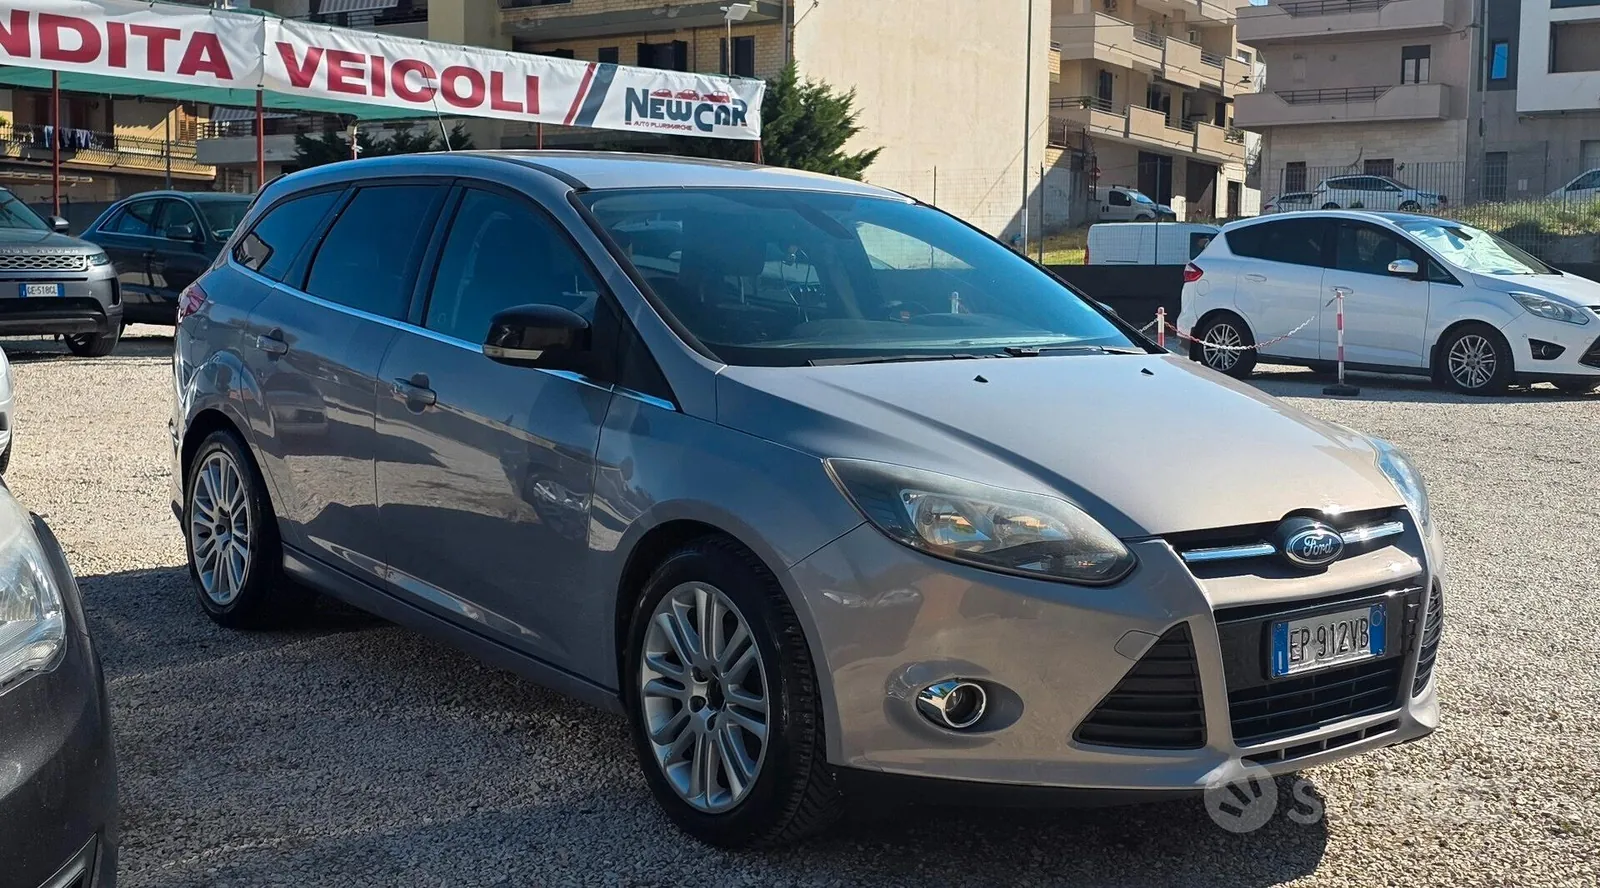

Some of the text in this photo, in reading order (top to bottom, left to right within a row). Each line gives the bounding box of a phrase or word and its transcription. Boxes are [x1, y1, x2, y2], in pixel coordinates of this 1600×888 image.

[274, 41, 540, 115] VEICOLI
[1303, 534, 1334, 557] Ford
[1289, 618, 1369, 662] EP 912VB
